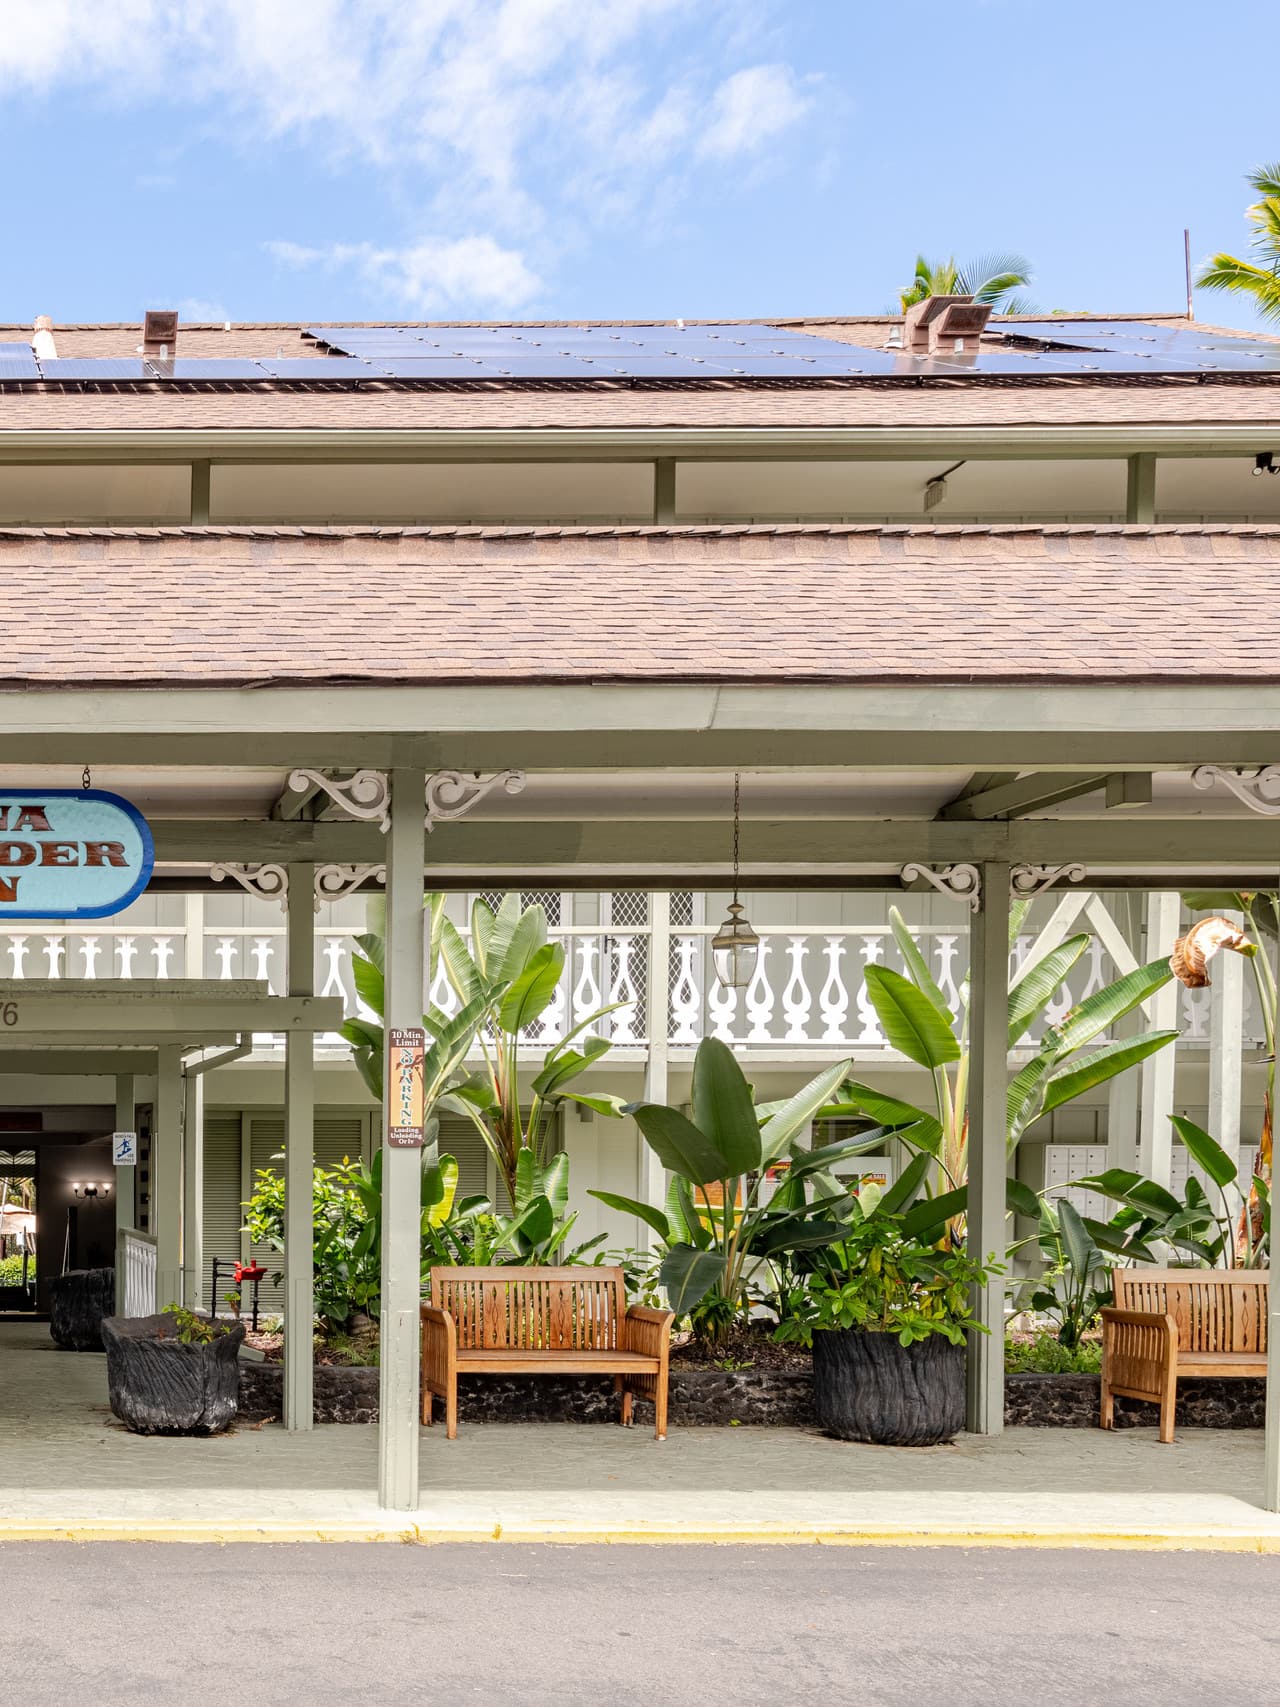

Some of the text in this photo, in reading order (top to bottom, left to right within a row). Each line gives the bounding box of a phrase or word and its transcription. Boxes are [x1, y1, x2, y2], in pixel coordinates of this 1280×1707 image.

[391, 1031, 424, 1039] 10 Min.
[400, 1049, 414, 1126] NO PARKING
